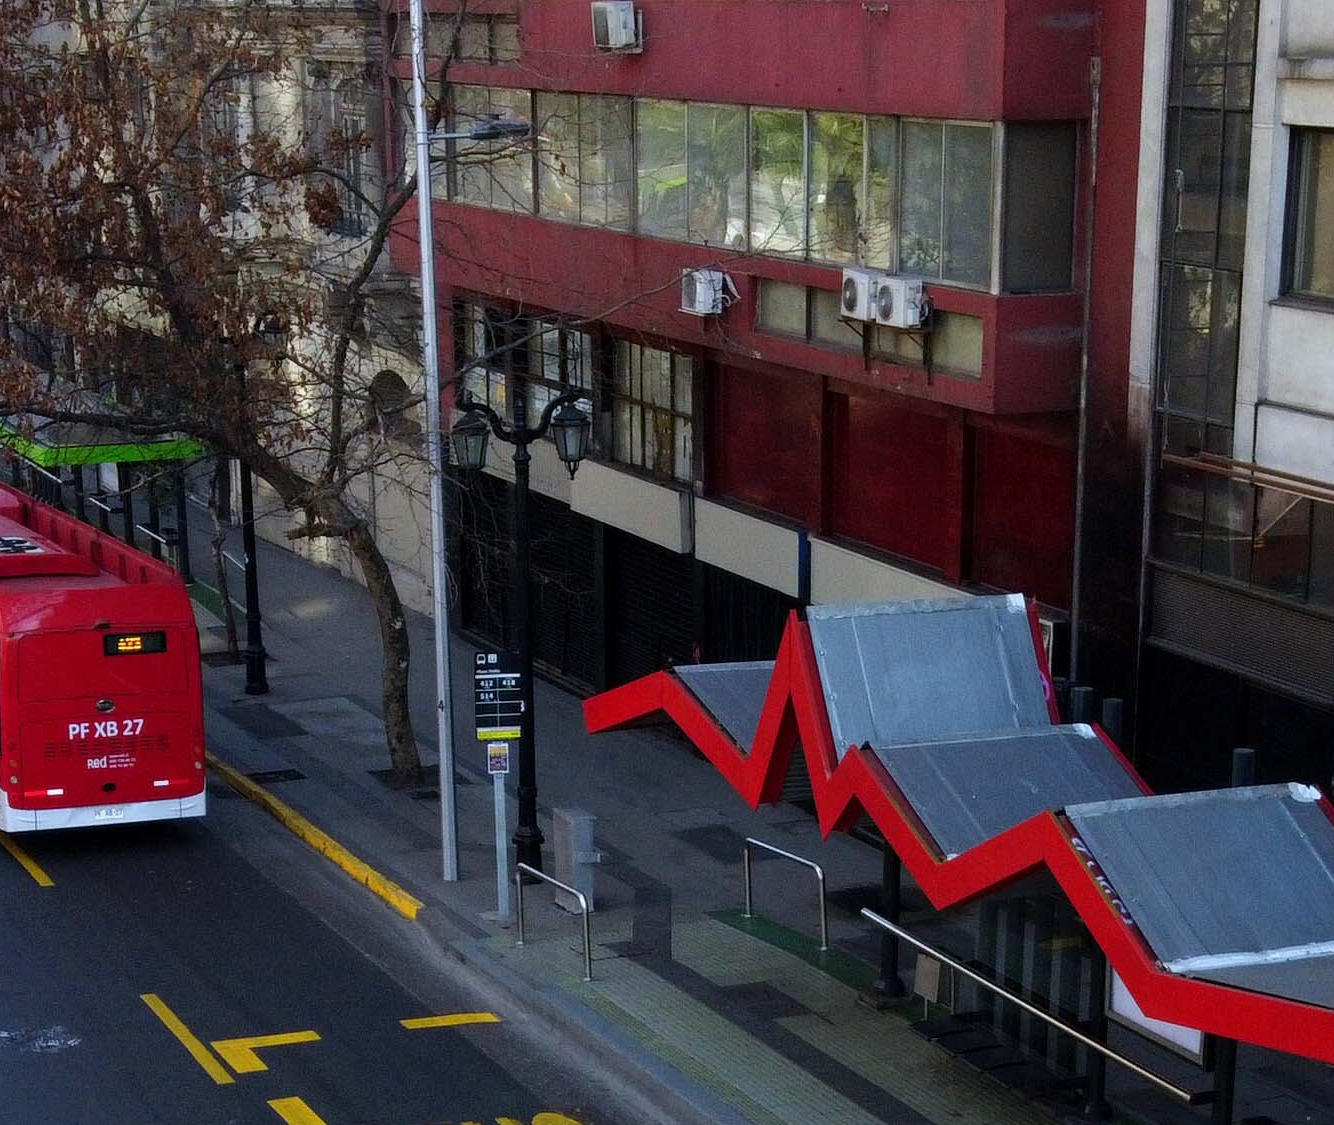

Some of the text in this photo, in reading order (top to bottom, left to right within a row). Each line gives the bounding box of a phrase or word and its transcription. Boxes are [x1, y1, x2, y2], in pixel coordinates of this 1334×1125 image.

[68, 719, 144, 740] PF XB 27
